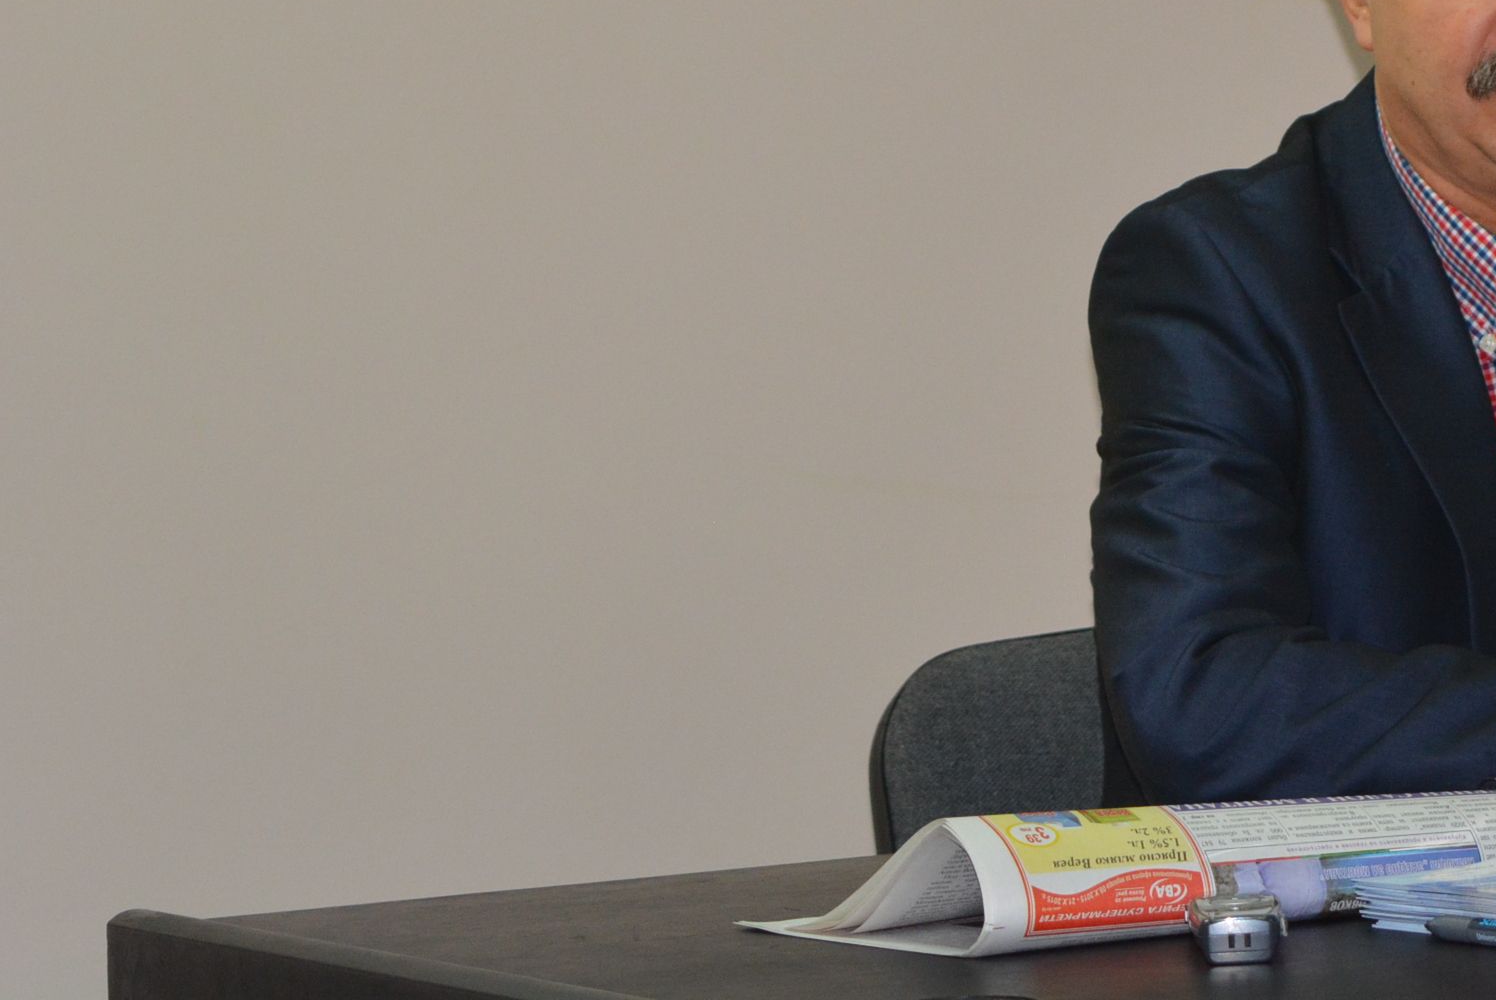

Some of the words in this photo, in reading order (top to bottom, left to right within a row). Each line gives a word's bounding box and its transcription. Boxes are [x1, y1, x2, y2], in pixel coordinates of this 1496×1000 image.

[1149, 837, 1180, 850] 1.5%
[1052, 855, 1091, 869] Верея
[1095, 854, 1135, 865] мляко
[1139, 849, 1188, 863] Прясно
[1155, 883, 1182, 898] CBA
[1148, 903, 1186, 915] ЕРИГА
[1329, 899, 1364, 911] ВКОВ
[1039, 906, 1145, 923] СУПЕРМАРКЕТИ
